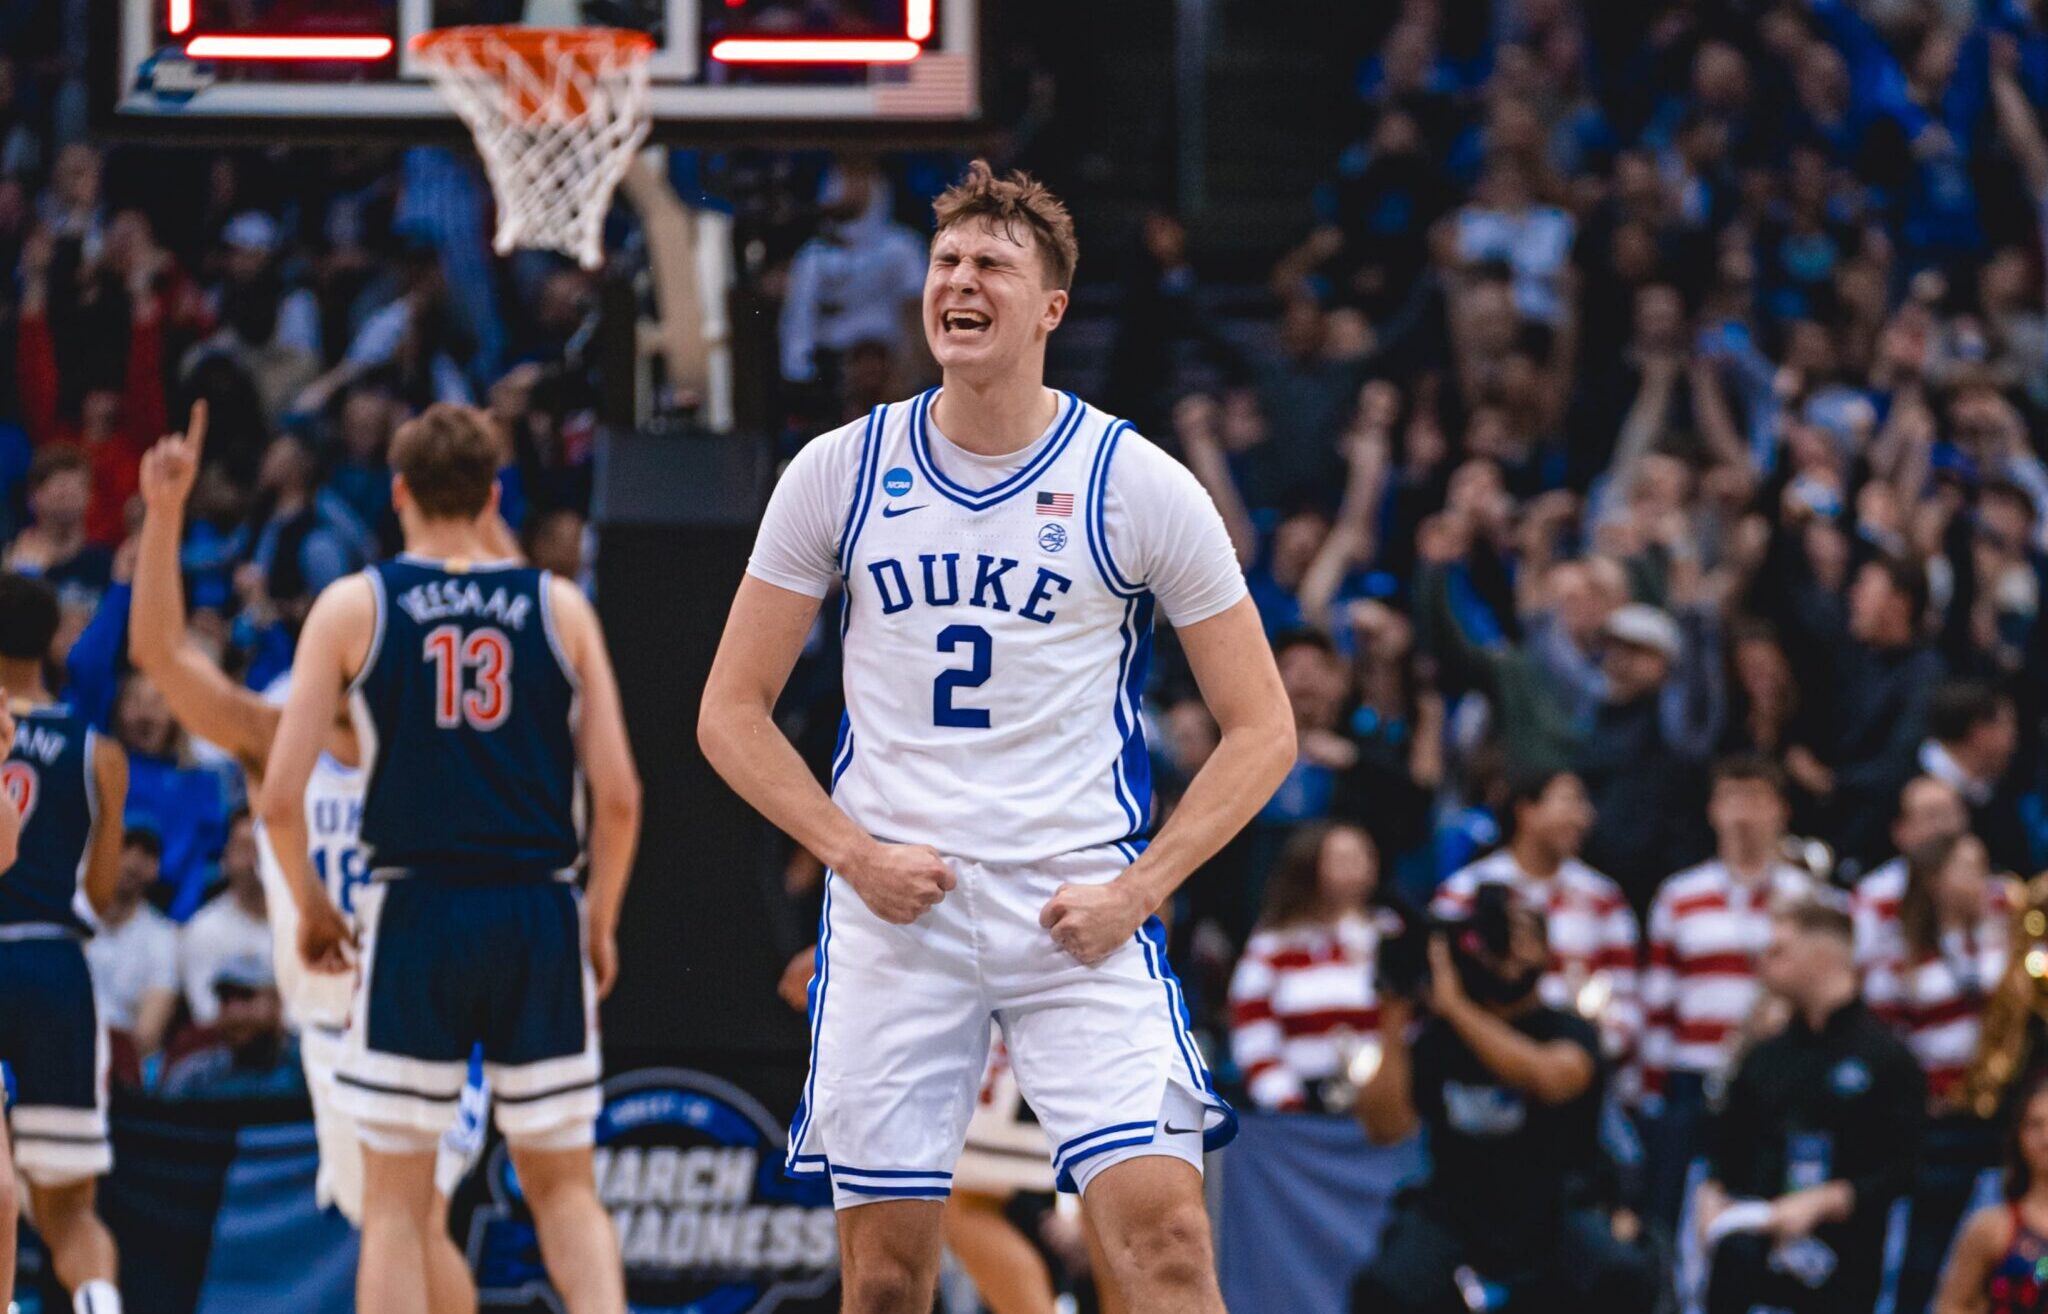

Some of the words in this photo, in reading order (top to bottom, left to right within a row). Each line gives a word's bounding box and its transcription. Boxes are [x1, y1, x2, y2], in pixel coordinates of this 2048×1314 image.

[886, 480, 912, 490] NCAA
[867, 553, 1072, 624] DUKE
[423, 624, 514, 732] 13
[933, 624, 992, 729] 2
[14, 720, 67, 766] ANT
